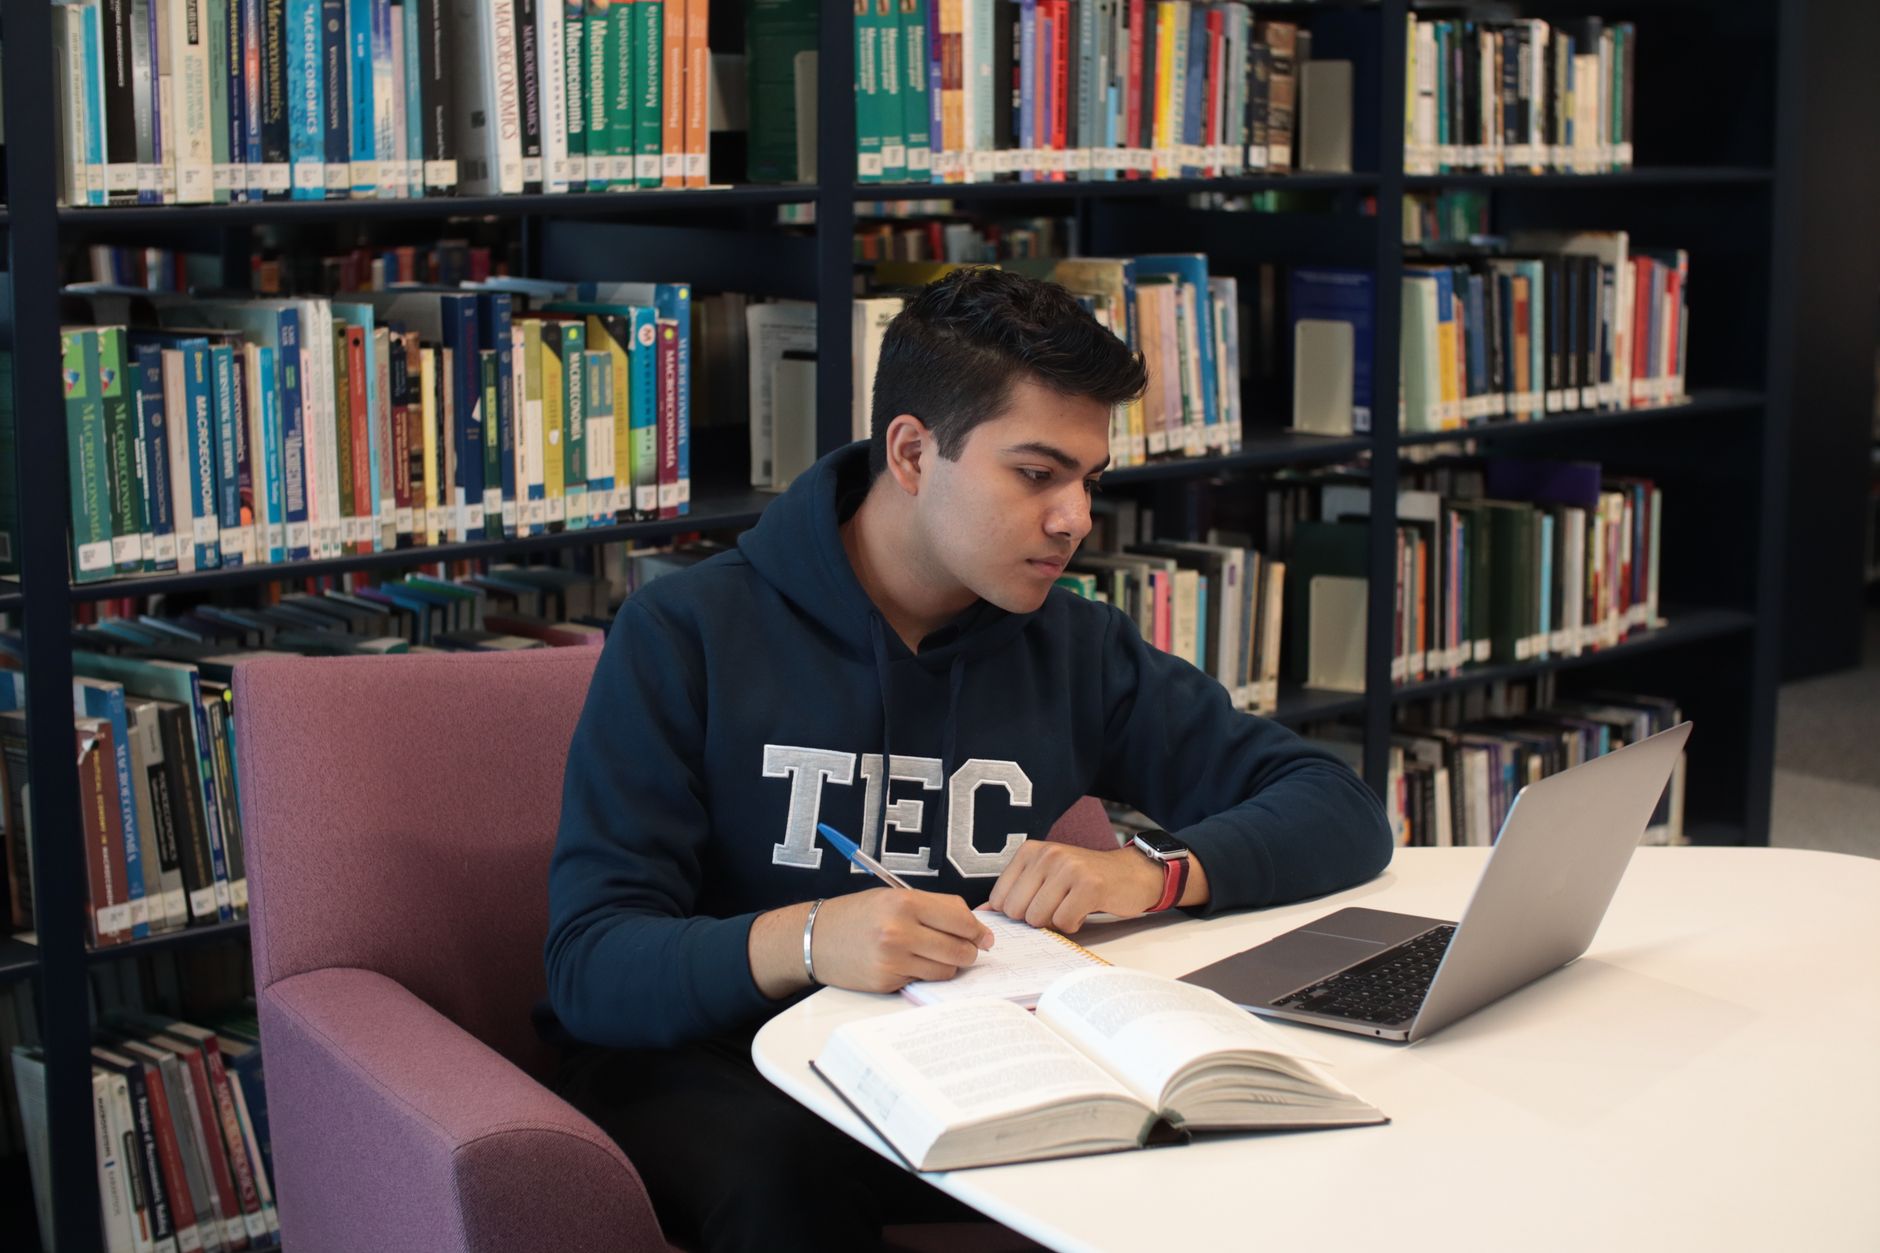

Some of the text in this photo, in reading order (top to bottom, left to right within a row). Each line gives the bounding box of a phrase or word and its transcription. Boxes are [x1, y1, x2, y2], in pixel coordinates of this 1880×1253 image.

[303, 3, 318, 136] MACROECONOMICS
[494, 1, 519, 141] MACROECONOMICS
[522, 24, 538, 137] MACROECONOMICS
[196, 395, 213, 516] MACROECONOMI
[663, 349, 678, 469] MACROECONOMÍA
[762, 744, 1033, 878] TEC
[103, 845, 114, 906] MACROECONOM
